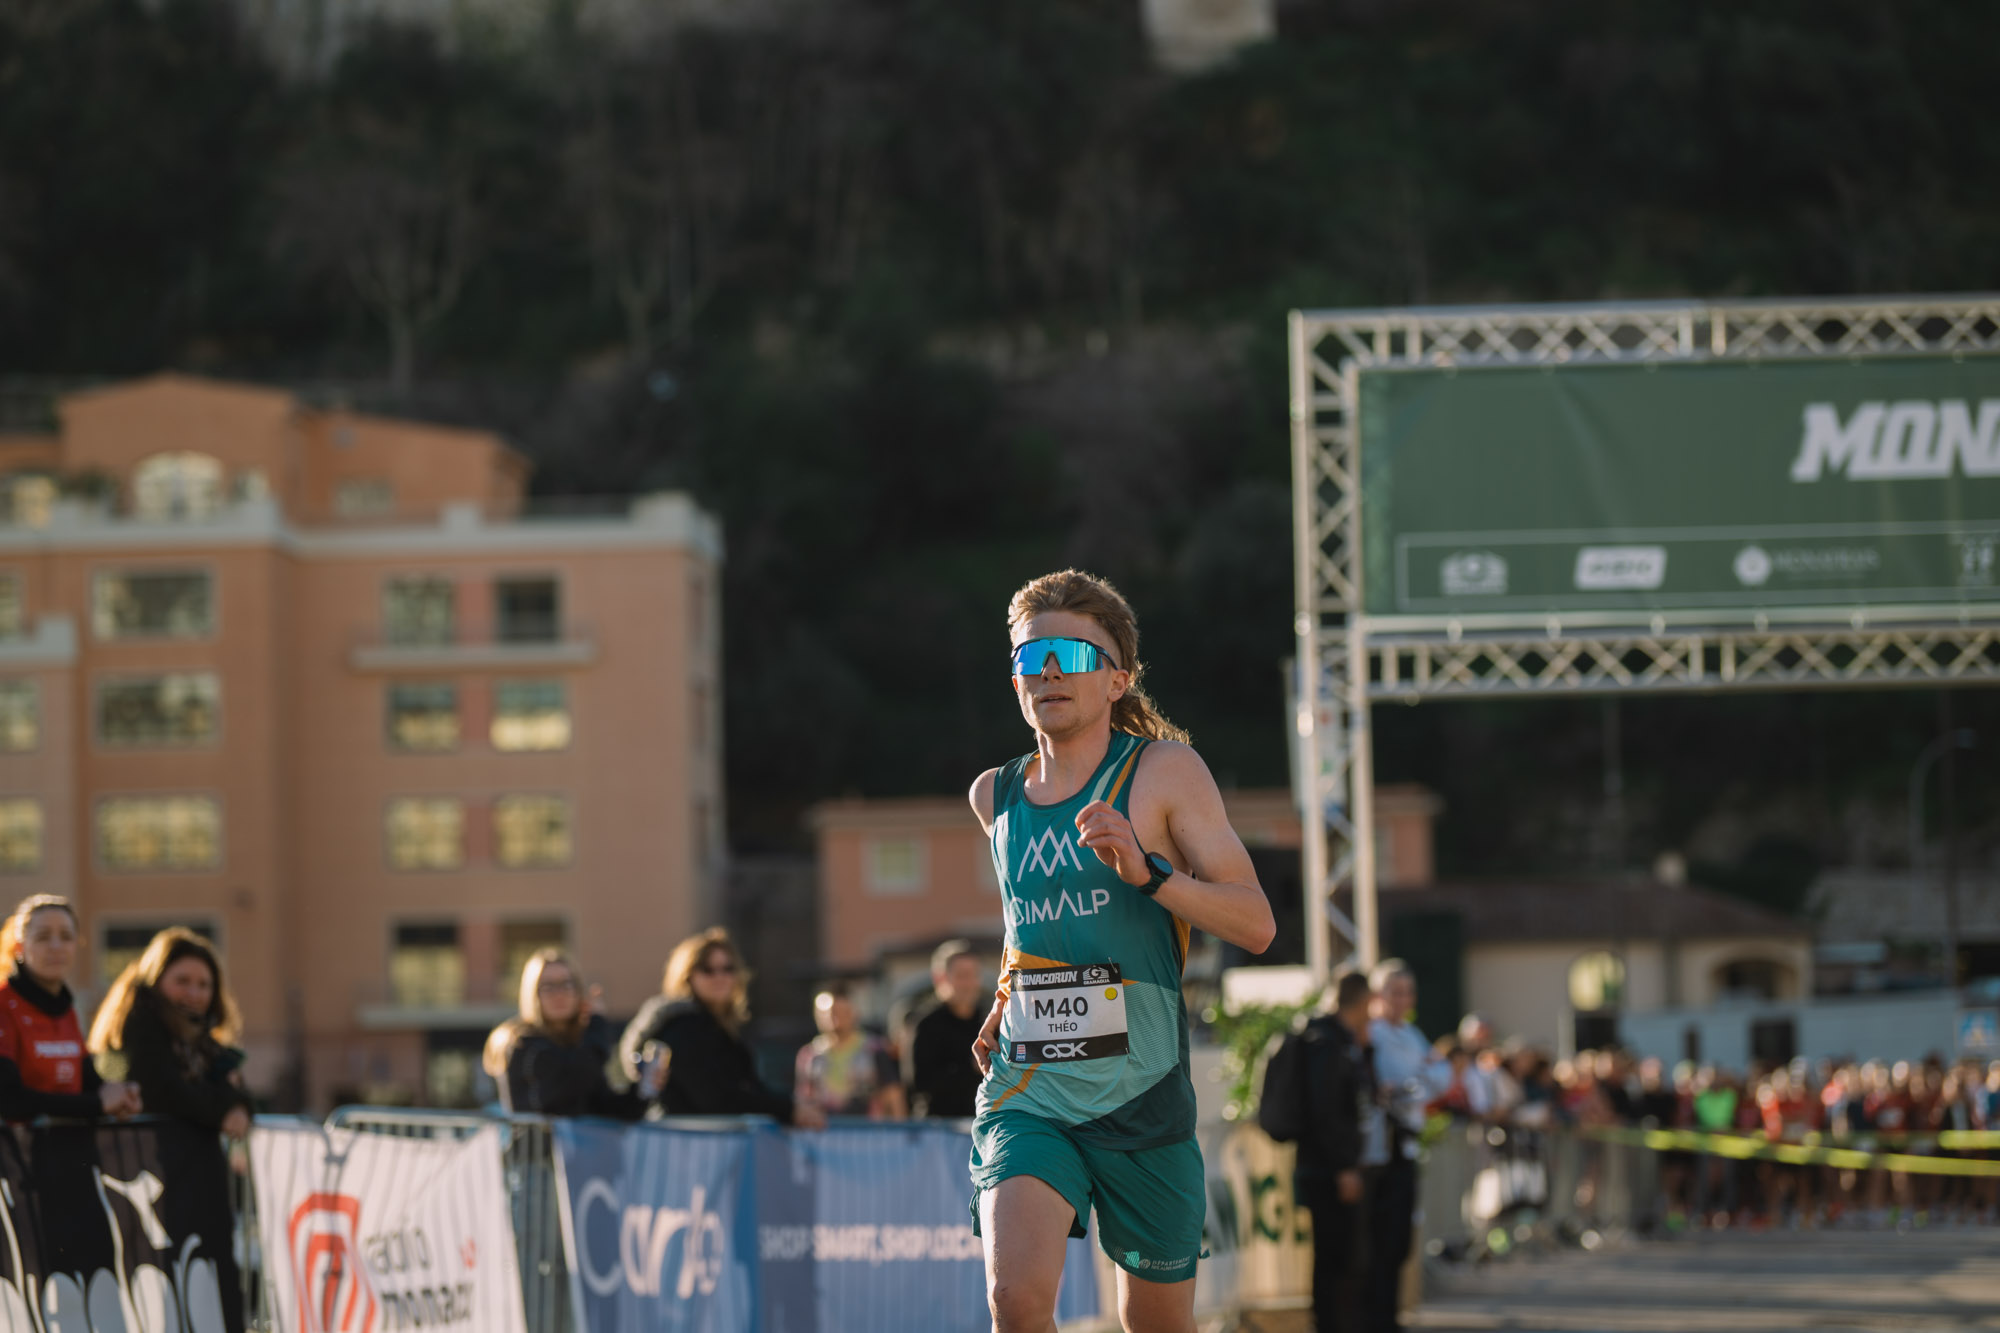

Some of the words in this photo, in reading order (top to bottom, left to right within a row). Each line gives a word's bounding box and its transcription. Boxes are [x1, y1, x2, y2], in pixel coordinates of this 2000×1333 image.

[1791, 398, 2000, 482] MON
[1009, 888, 1110, 927] CIMALP
[1034, 996, 1088, 1019] M40
[1048, 1020, 1078, 1033] THÉO
